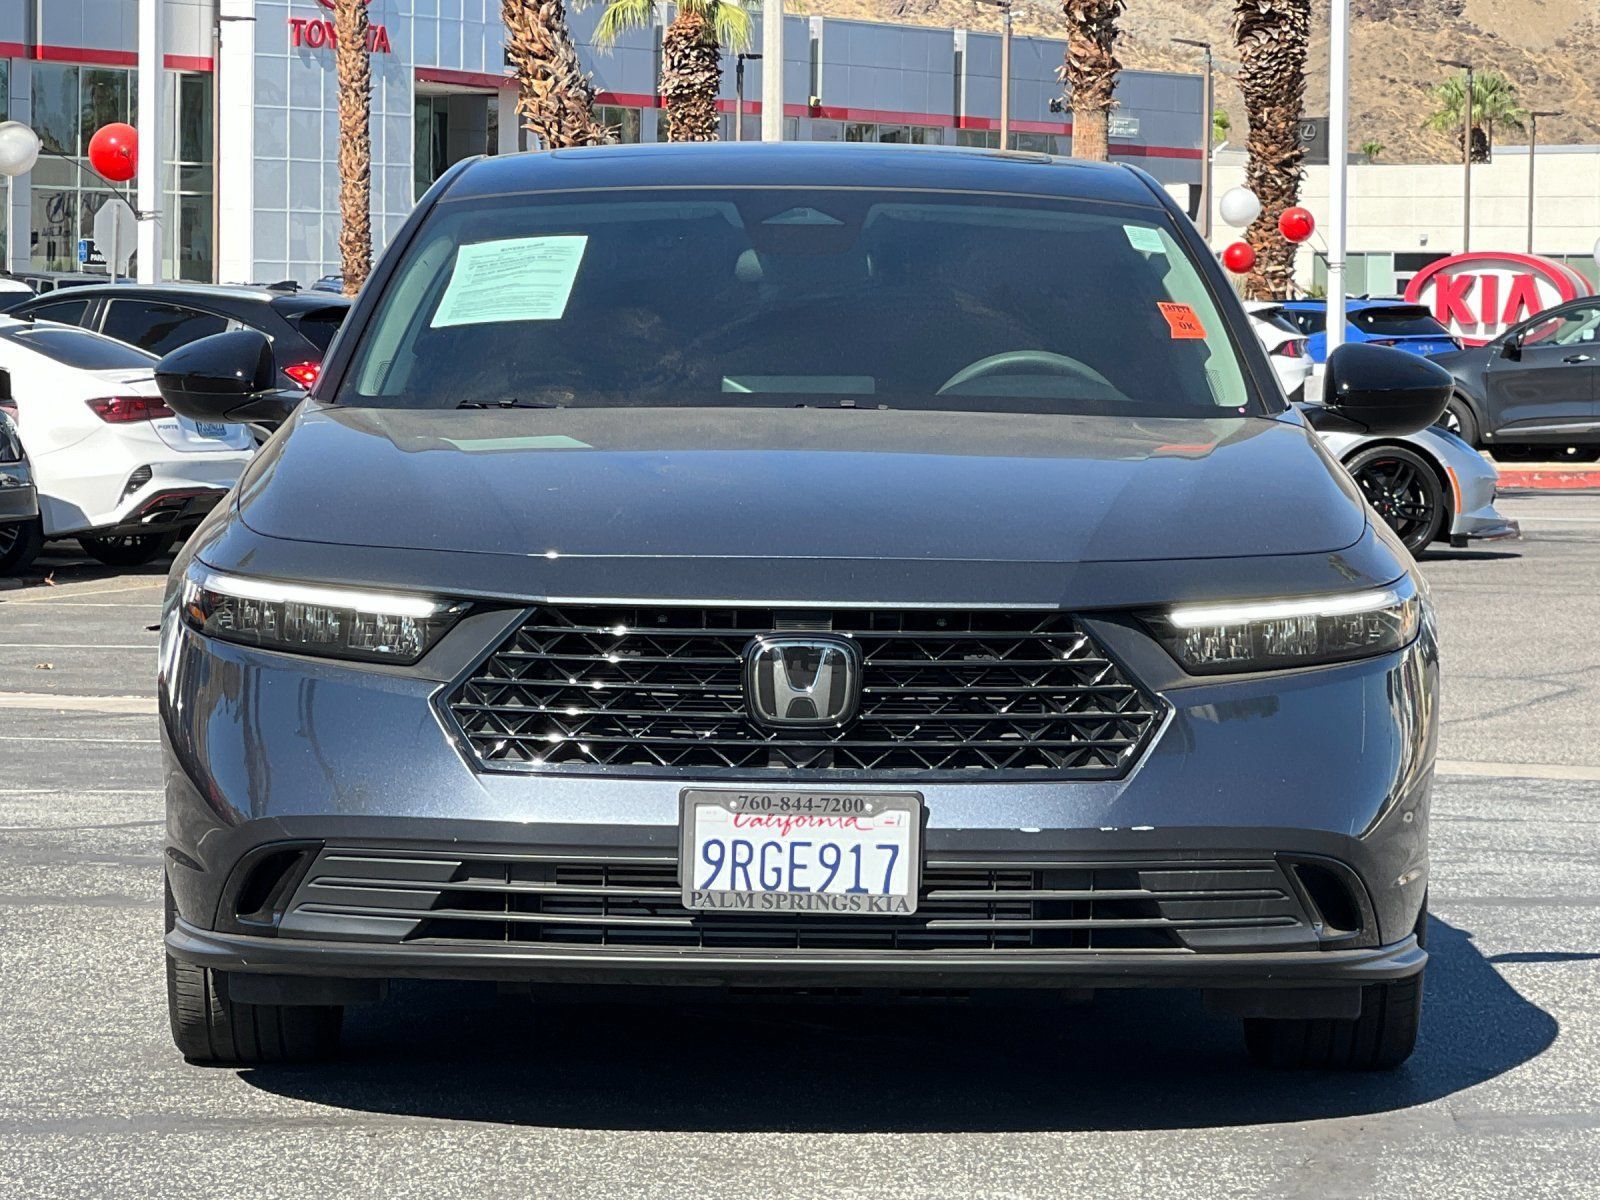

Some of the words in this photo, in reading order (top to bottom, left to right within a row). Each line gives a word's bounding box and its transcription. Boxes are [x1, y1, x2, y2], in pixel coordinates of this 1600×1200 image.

[288, 19, 391, 53] TOYTA
[1161, 303, 1191, 314] SAFETY
[1433, 274, 1544, 325] KIA
[1178, 321, 1196, 331] OK
[738, 795, 865, 813] 760-844-7200
[733, 812, 873, 837] California
[700, 838, 900, 895] 9RGE917
[689, 891, 756, 909] PALM
[761, 893, 862, 911] SPRINGS
[866, 895, 911, 913] KIA
